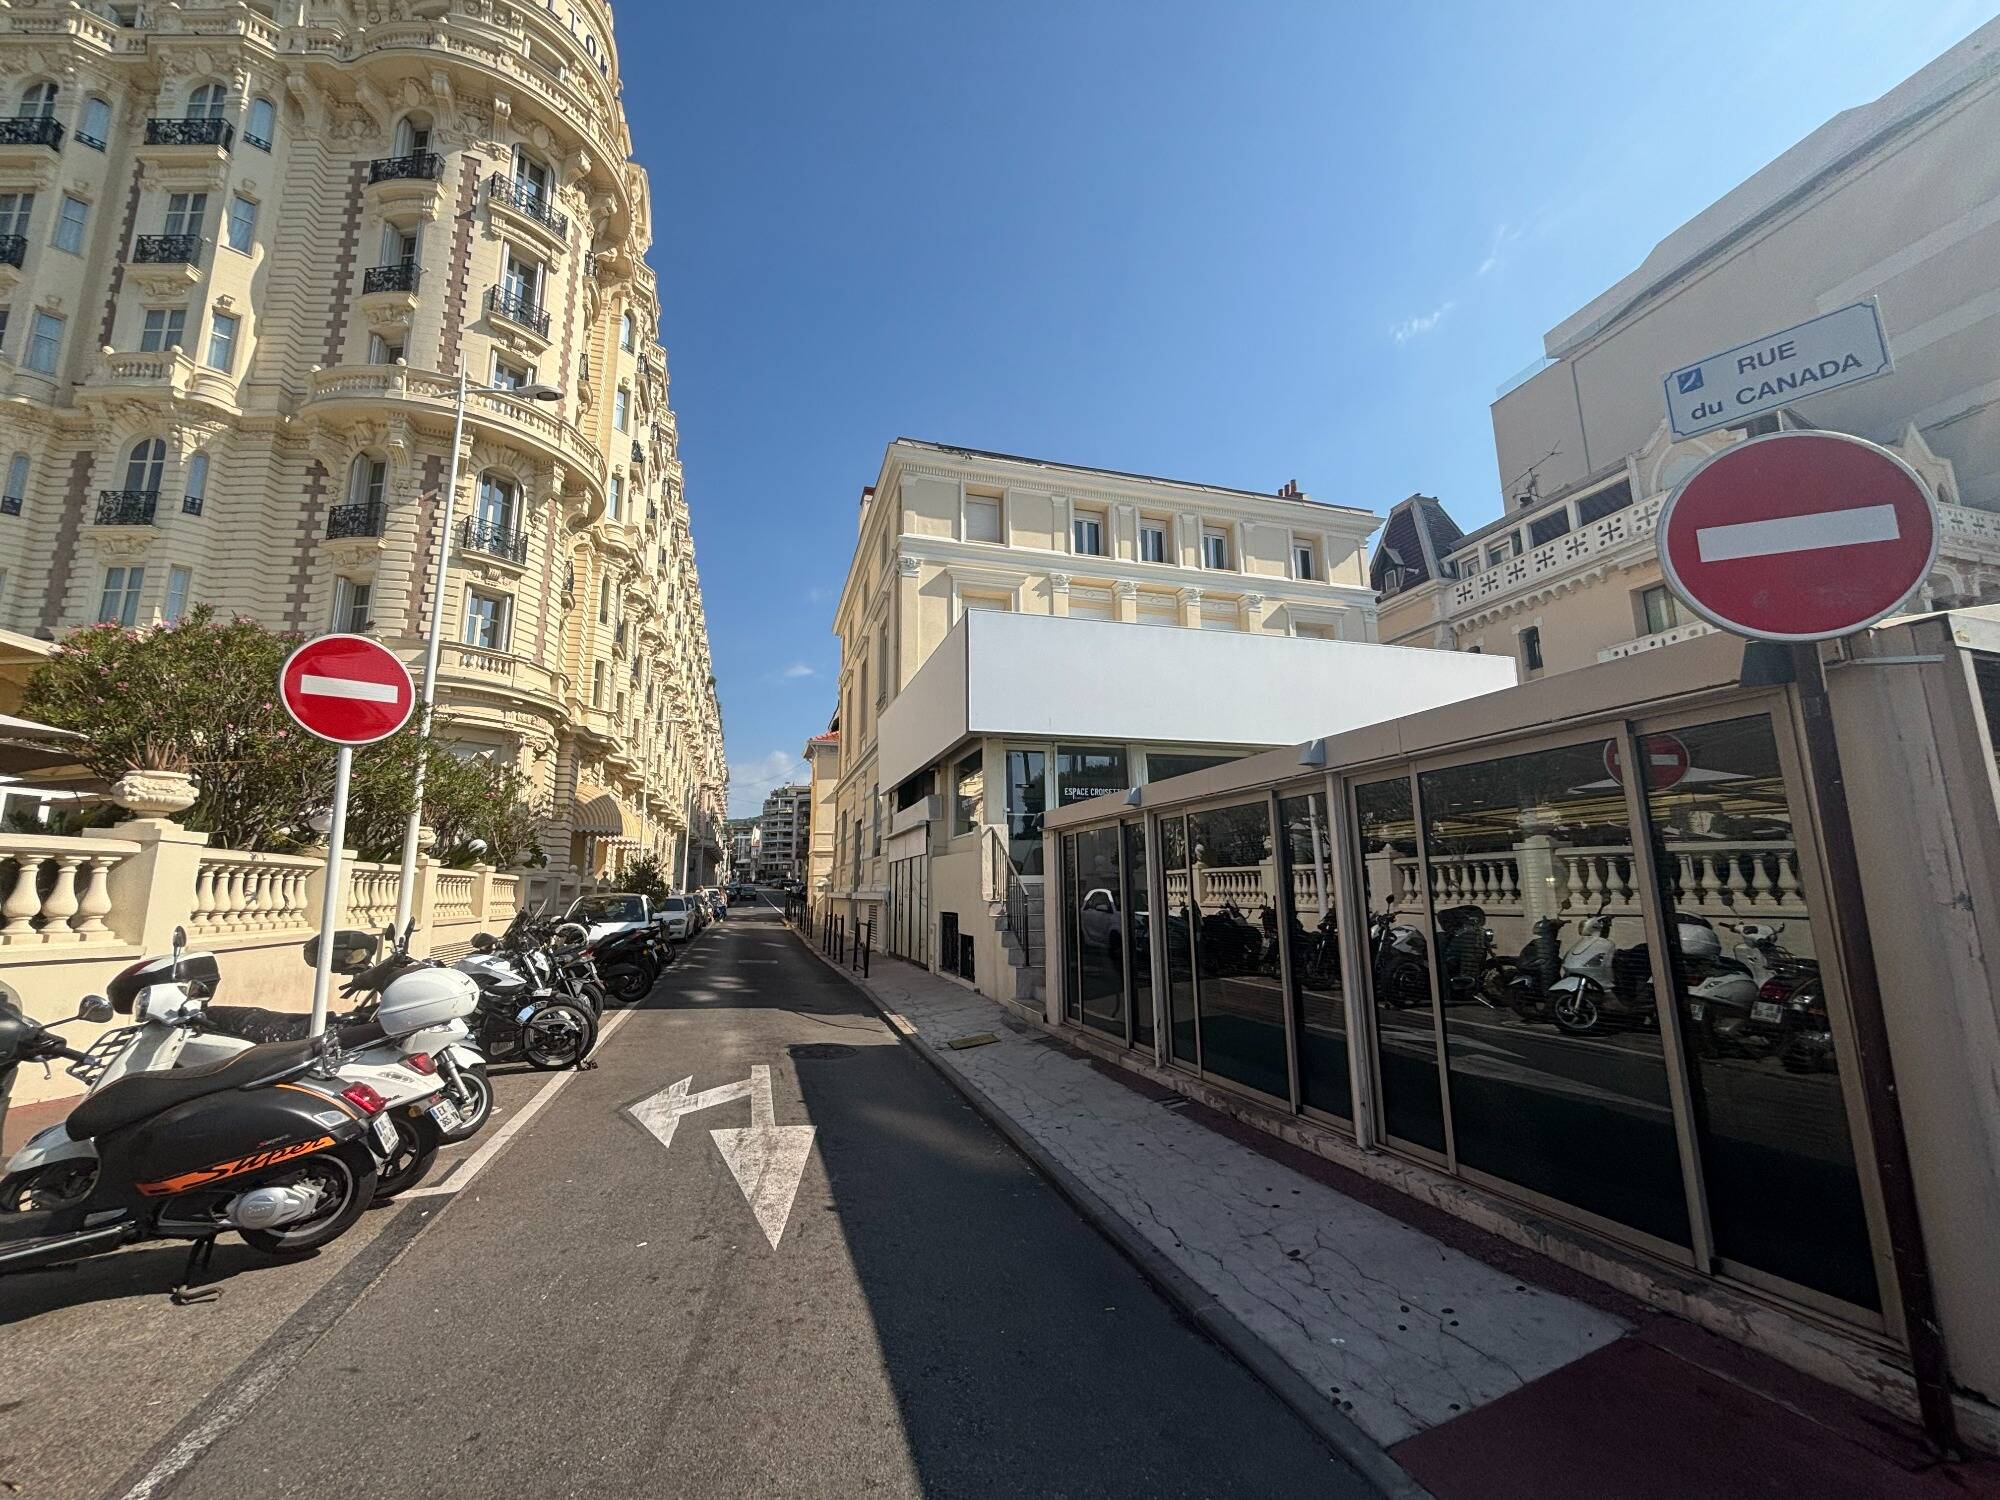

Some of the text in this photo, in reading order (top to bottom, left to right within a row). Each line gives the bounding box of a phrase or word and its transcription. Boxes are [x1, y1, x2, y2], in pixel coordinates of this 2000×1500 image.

[1736, 340, 1797, 375] RUE
[1690, 352, 1863, 421] du CANADA
[1064, 787, 1089, 800] ESPACE
[181, 1137, 327, 1189] Super
